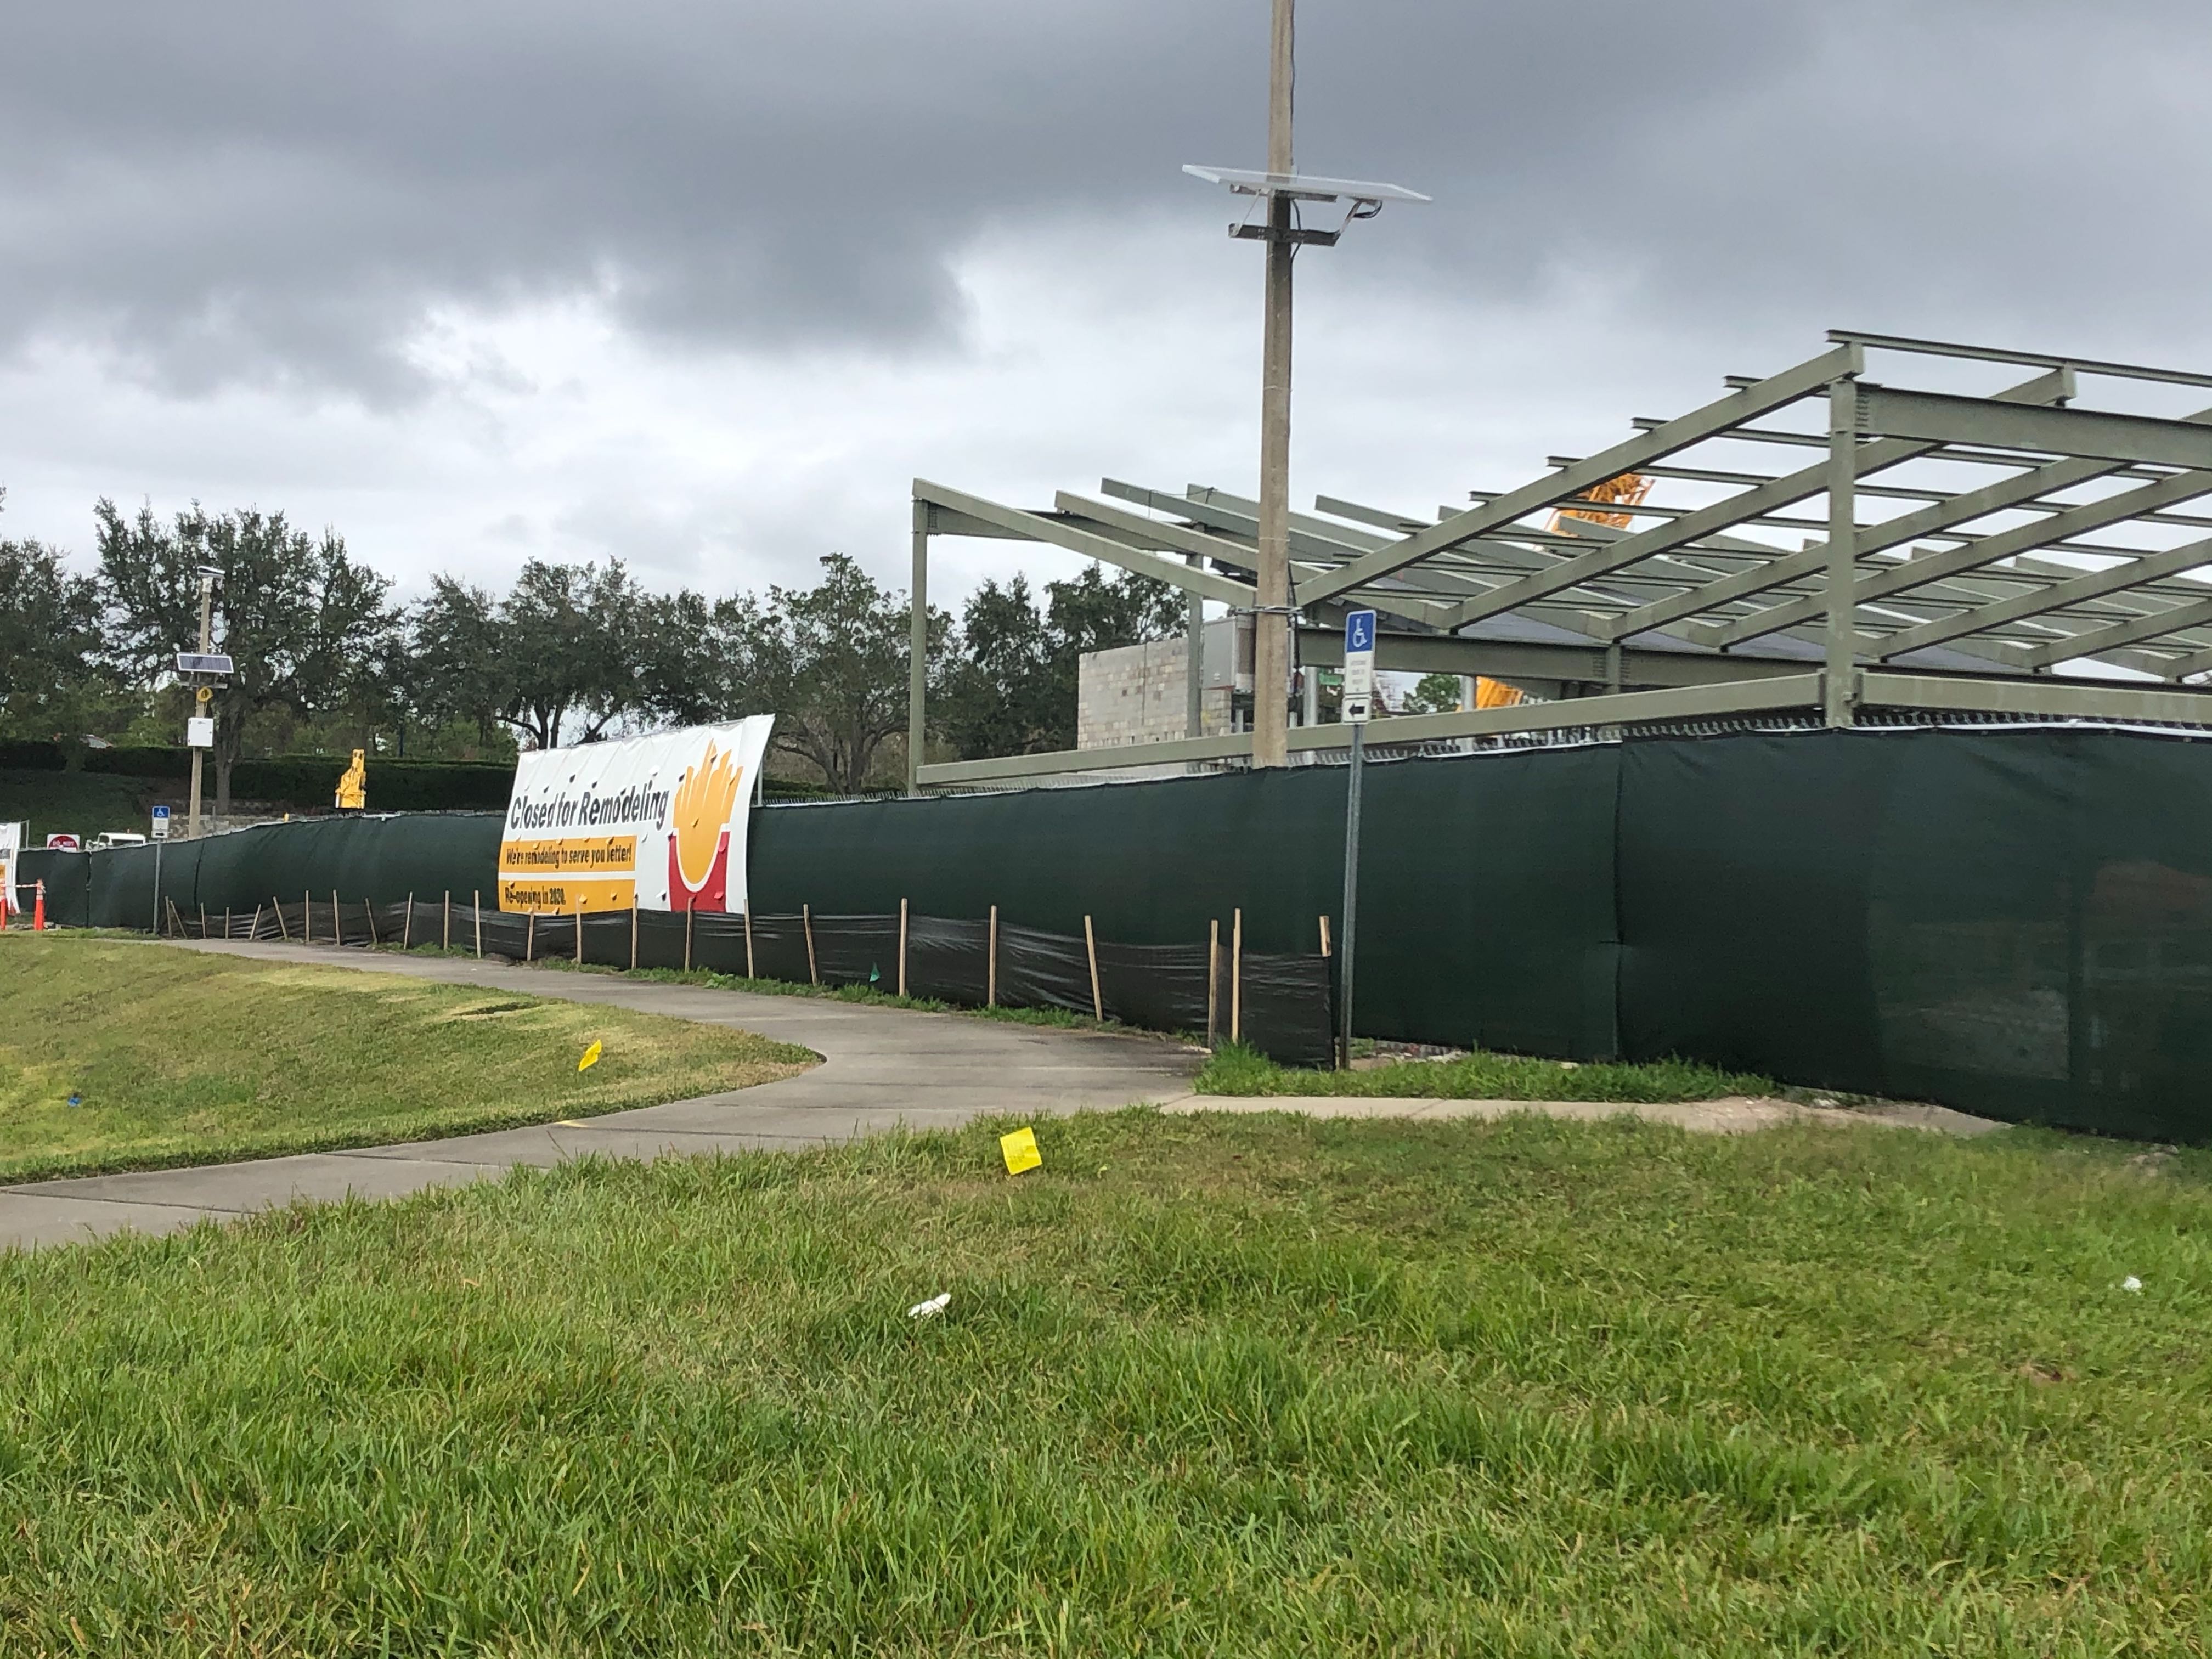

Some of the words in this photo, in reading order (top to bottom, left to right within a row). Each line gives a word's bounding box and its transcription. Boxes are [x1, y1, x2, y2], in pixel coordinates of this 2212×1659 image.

[511, 793, 559, 830] Closed
[556, 791, 578, 827] for
[578, 780, 670, 831] Remodeling
[561, 847, 567, 864] to
[569, 849, 590, 864] serve
[590, 849, 605, 869] you
